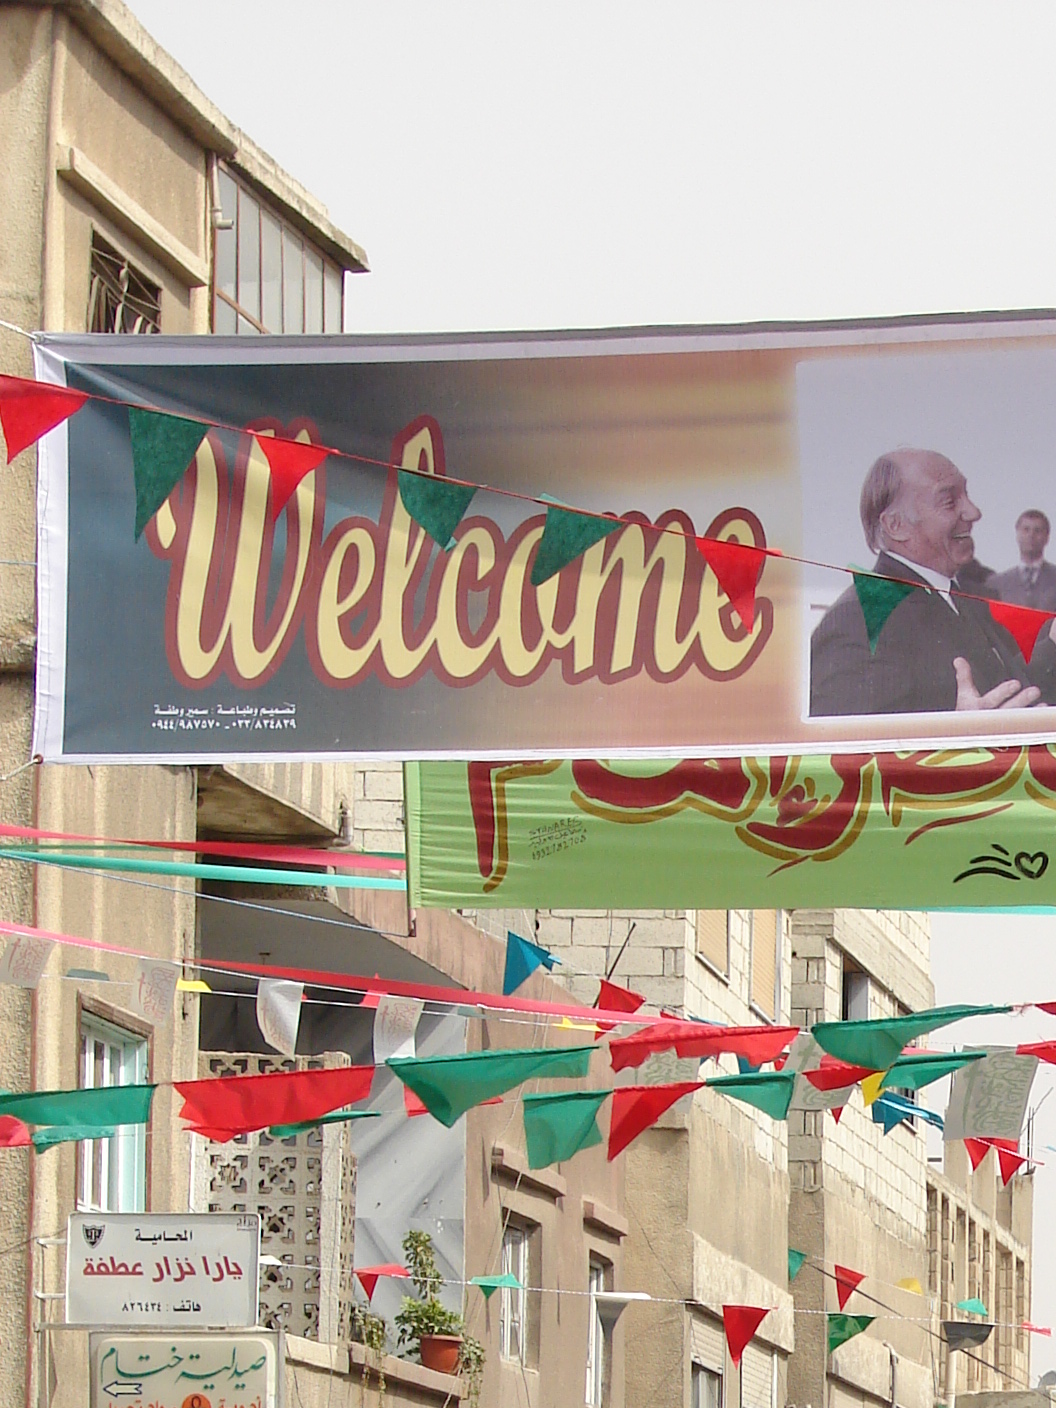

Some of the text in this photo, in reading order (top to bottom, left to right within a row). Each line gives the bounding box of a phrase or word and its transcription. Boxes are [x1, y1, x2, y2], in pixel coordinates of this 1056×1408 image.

[143, 416, 763, 690] Welcome
[134, 1228, 193, 1246] المحامية
[152, 1255, 196, 1283] نزار
[203, 1255, 243, 1283] يارا
[173, 1300, 202, 1312] هاتف
[175, 1346, 268, 1391] صيدلية
